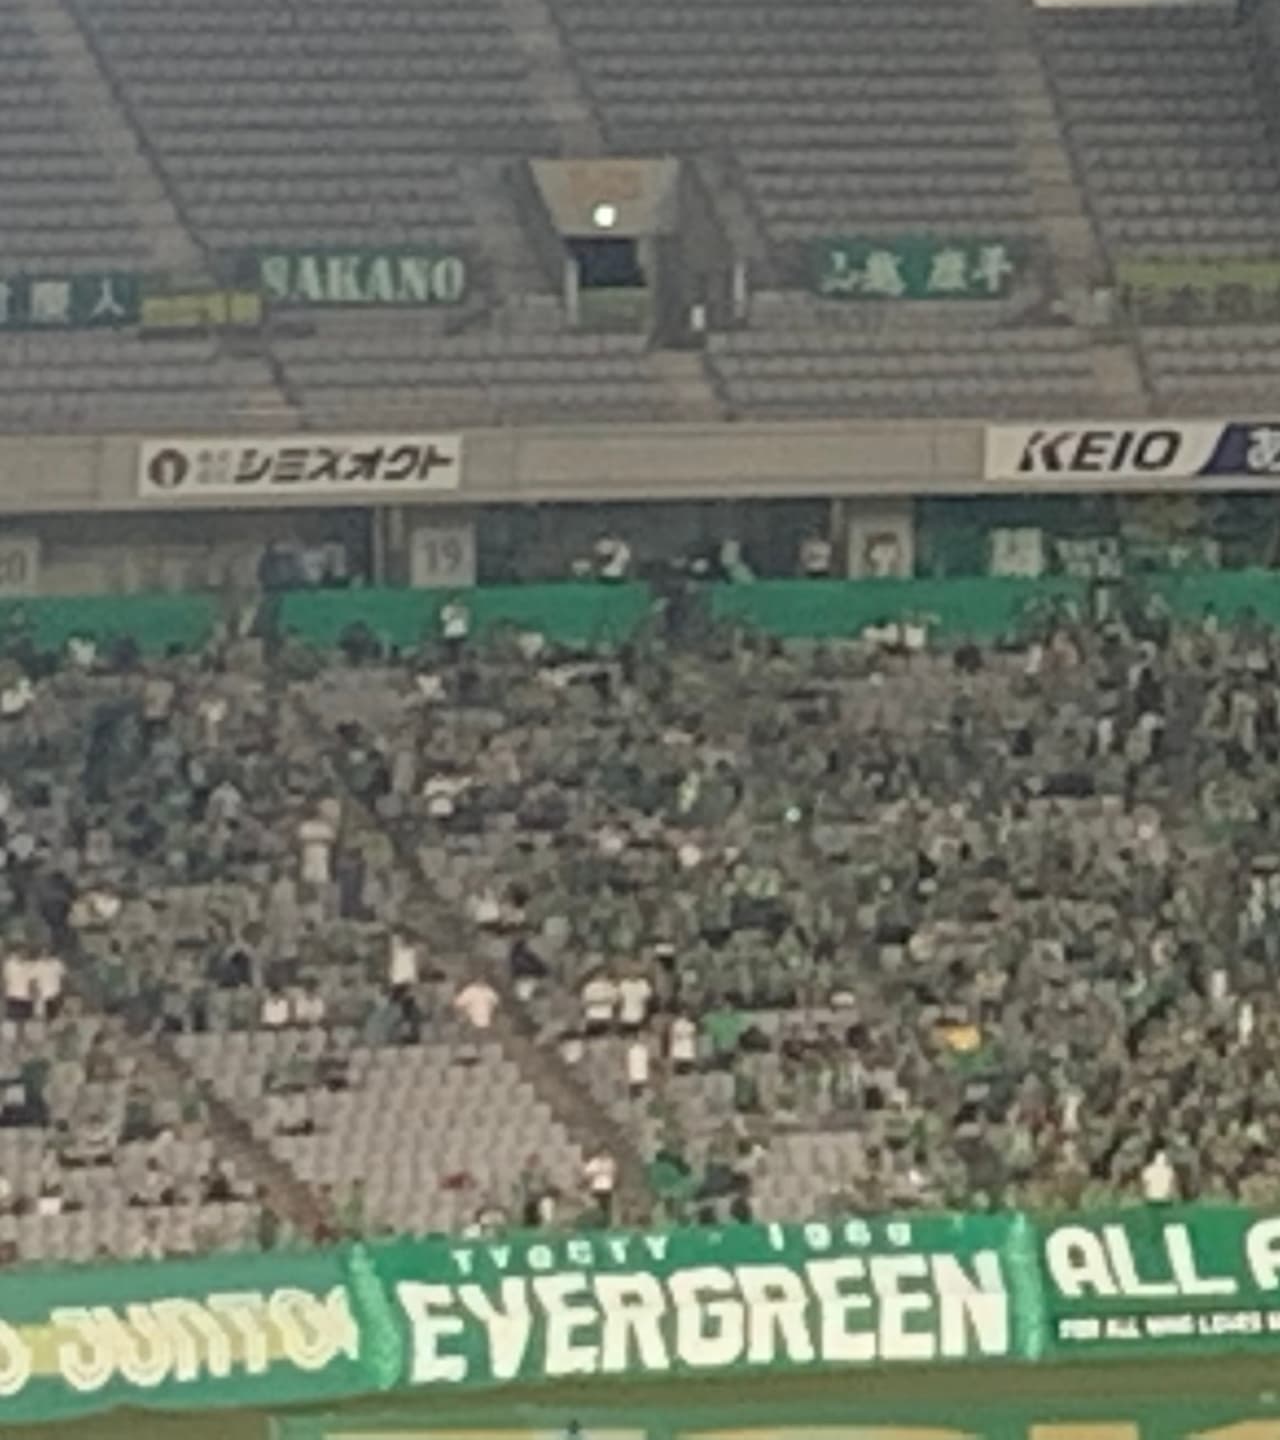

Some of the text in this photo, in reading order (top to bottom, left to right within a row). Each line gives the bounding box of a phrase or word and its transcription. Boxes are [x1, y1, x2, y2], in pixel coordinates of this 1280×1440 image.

[1019, 428, 1182, 472] KEIO
[1045, 1222, 1238, 1296] ALL
[397, 1250, 1009, 1383] EVERGREEN
